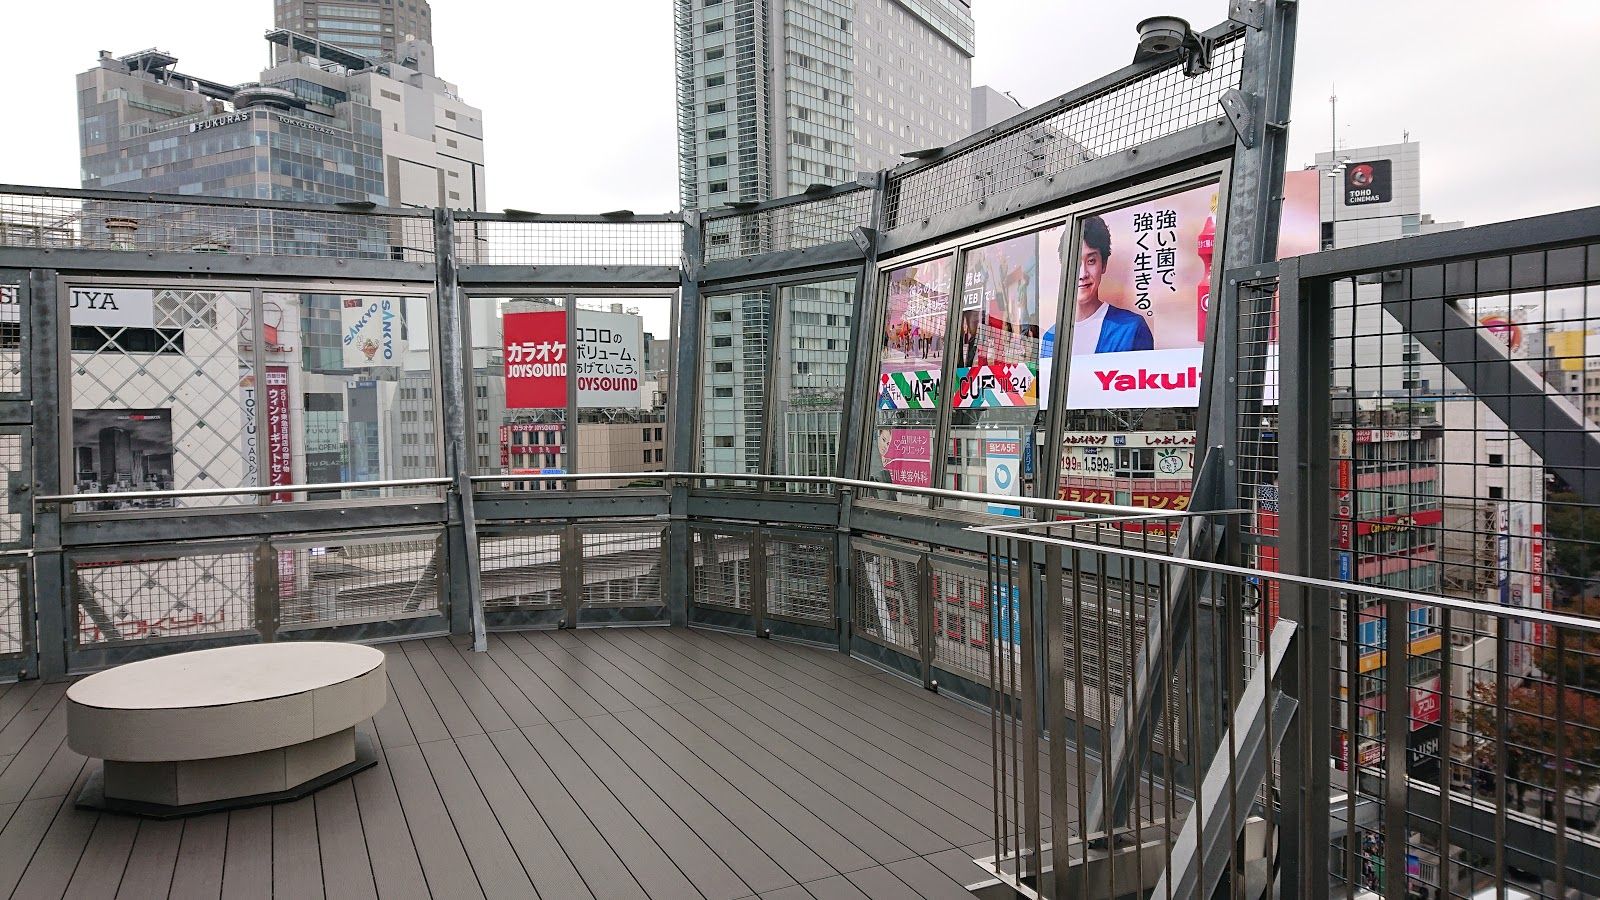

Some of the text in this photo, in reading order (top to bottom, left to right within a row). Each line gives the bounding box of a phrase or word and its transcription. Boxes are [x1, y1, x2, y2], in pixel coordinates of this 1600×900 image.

[198, 112, 249, 130] FUKURAS
[308, 124, 336, 136] PLAZA
[1349, 189, 1372, 197] TOHO
[1350, 195, 1380, 203] CINEMAS
[1155, 210, 1177, 292] 強い菌で、
[1134, 213, 1153, 317] 強く生きる。
[344, 303, 378, 346] SANKYO
[382, 300, 395, 360] SANKYO
[507, 341, 567, 363] カラオケ
[508, 363, 567, 378] JOYSOUND
[578, 377, 638, 391] OYSOUND
[904, 375, 995, 402] JAPA CUP
[900, 435, 927, 444] 品川スキン
[1063, 435, 1108, 445] ゃぶバイキング
[901, 446, 926, 455] クリニック
[989, 443, 1016, 452] 当ビル5F
[1413, 738, 1439, 762] LUSH
